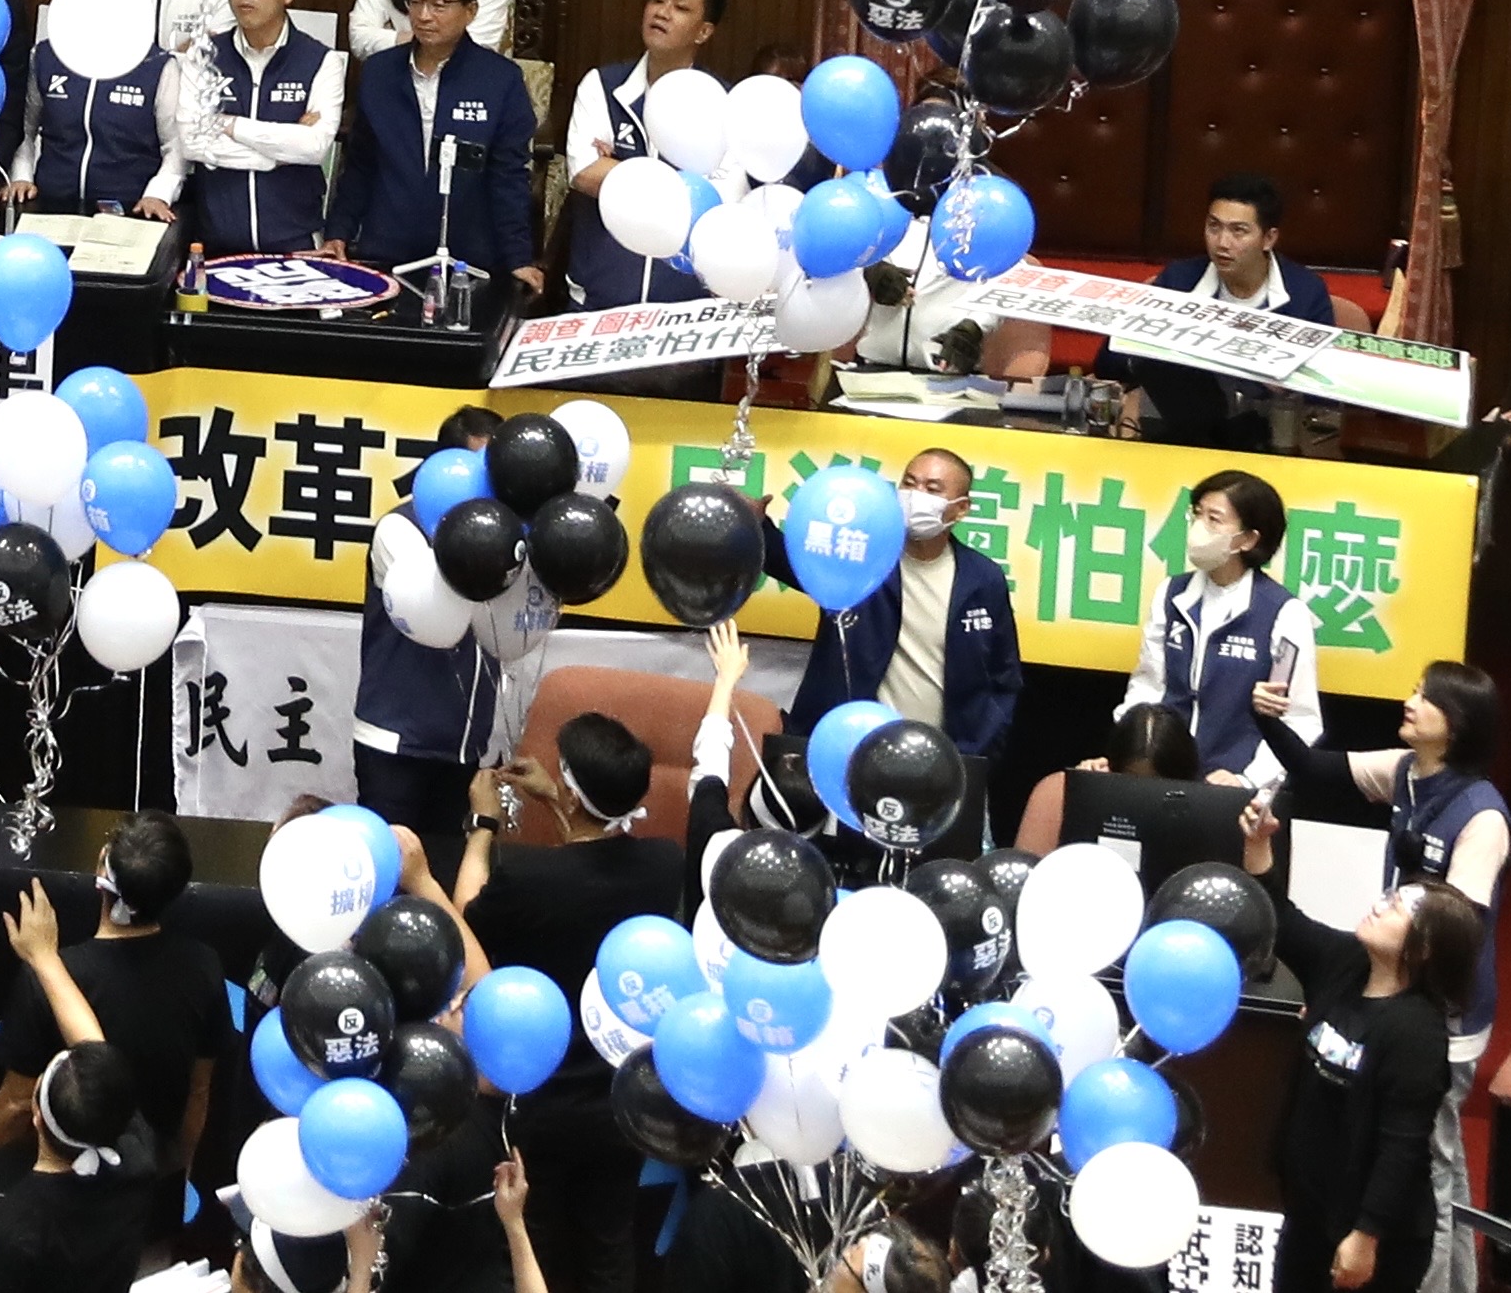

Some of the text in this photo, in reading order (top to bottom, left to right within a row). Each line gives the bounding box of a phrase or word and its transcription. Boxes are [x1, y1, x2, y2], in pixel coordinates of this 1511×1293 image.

[867, 1, 924, 31] 惡法
[967, 286, 1297, 366] 民進黨怕什麼?
[804, 519, 869, 564] 黑箱
[187, 674, 323, 769] 民主
[876, 796, 904, 822] 反
[982, 906, 1004, 935] 反
[337, 1006, 366, 1035] 反
[324, 1032, 380, 1064] 惡法
